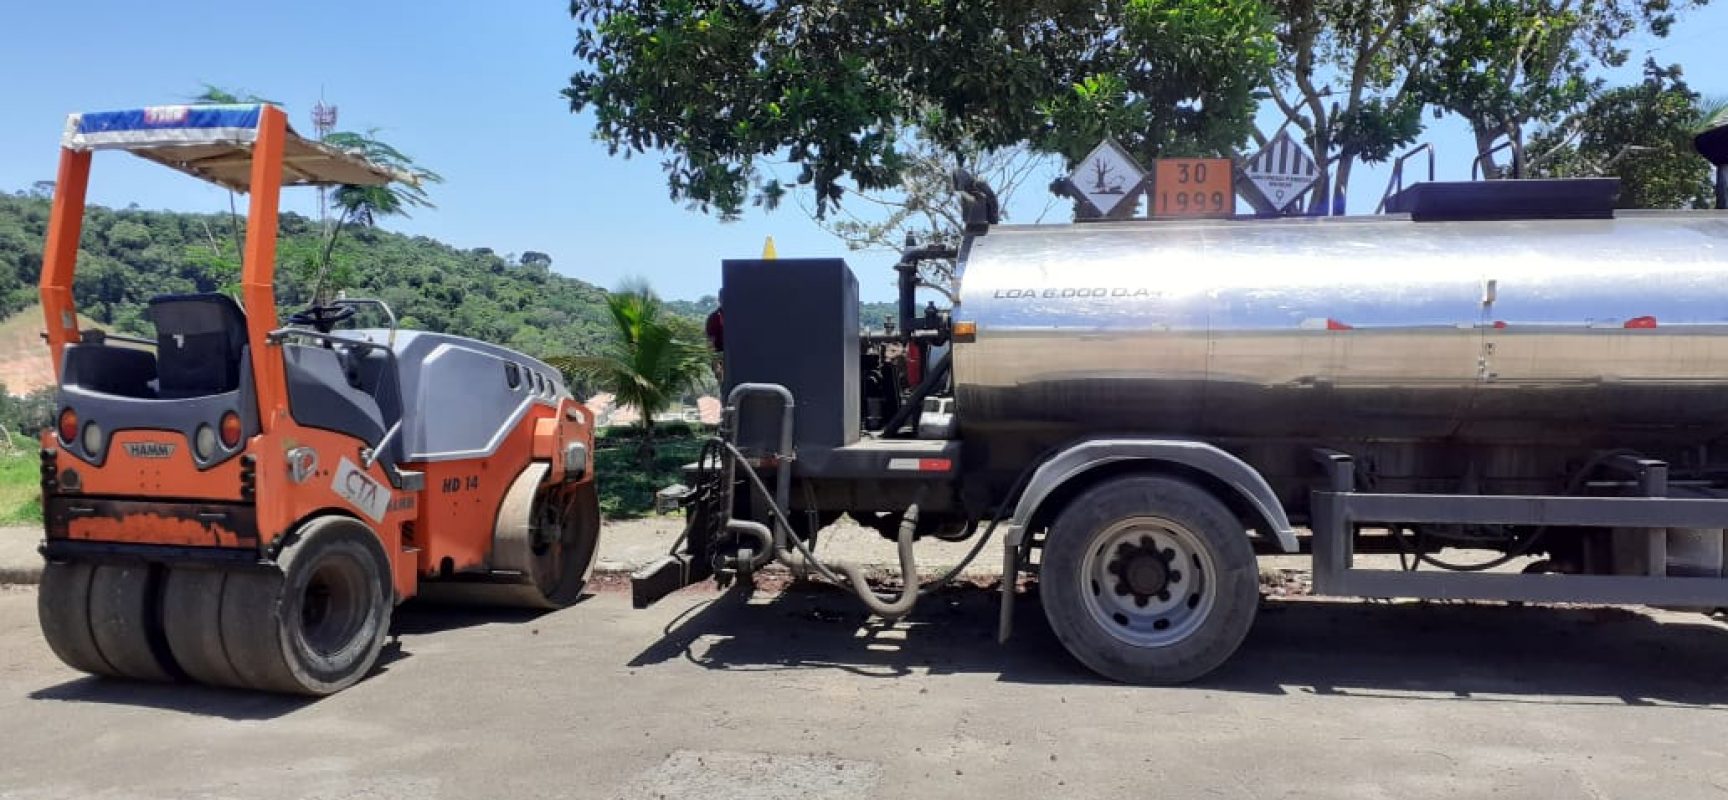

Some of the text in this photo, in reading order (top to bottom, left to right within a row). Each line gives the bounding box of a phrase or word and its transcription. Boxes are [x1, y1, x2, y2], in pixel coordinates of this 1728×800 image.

[1177, 163, 1206, 184] 30
[1163, 191, 1223, 211] 1999
[130, 443, 169, 456] HAMM
[442, 475, 478, 493] HD 14
